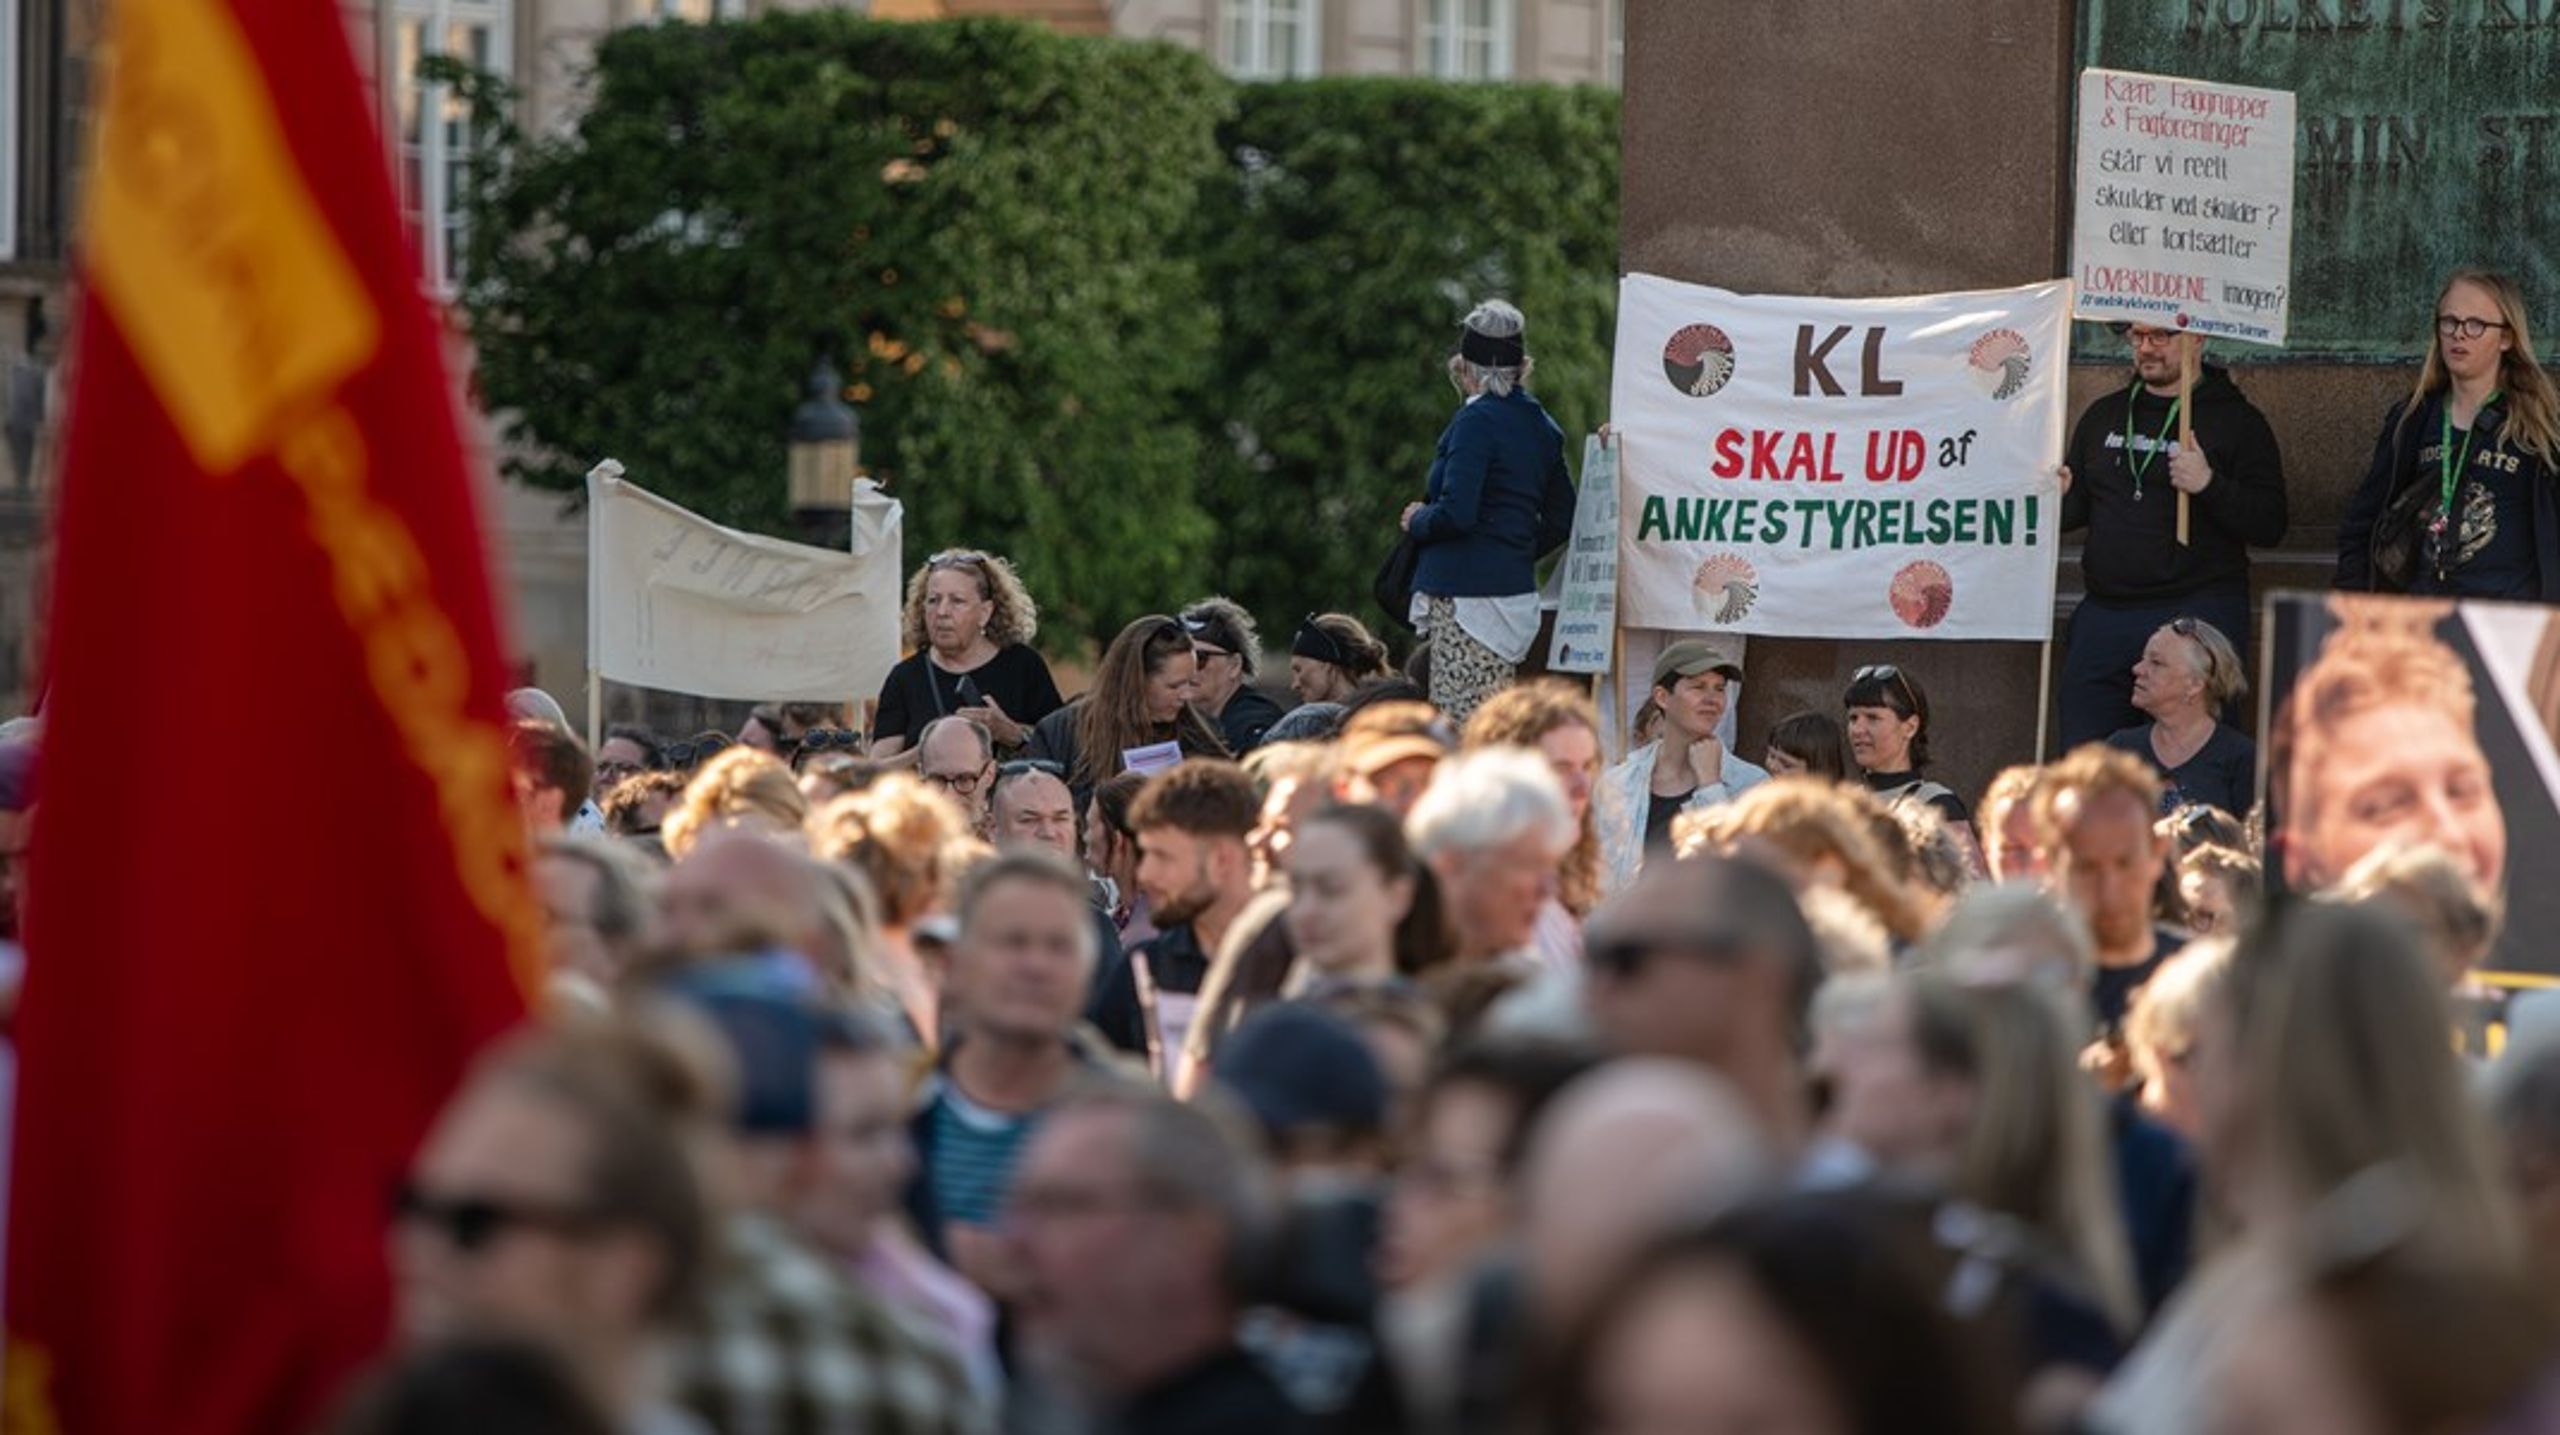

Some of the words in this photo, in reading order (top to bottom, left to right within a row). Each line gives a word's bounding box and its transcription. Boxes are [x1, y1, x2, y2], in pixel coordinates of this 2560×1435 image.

[2171, 82, 2271, 120] Faggrupper
[2101, 106, 2116, 128] &
[2125, 106, 2254, 150] Fagforeninger
[2305, 114, 2428, 173] MIN
[2155, 150, 2174, 175] vi
[2183, 155, 2229, 180] reelt
[2171, 194, 2198, 217] ved
[2109, 221, 2150, 246] eller
[2084, 264, 2212, 303] LOVBRUDDENE
[1794, 325, 1903, 397] KL
[1711, 428, 1843, 483] SKAL
[1865, 430, 1926, 482] UD
[1939, 429, 1977, 468] af
